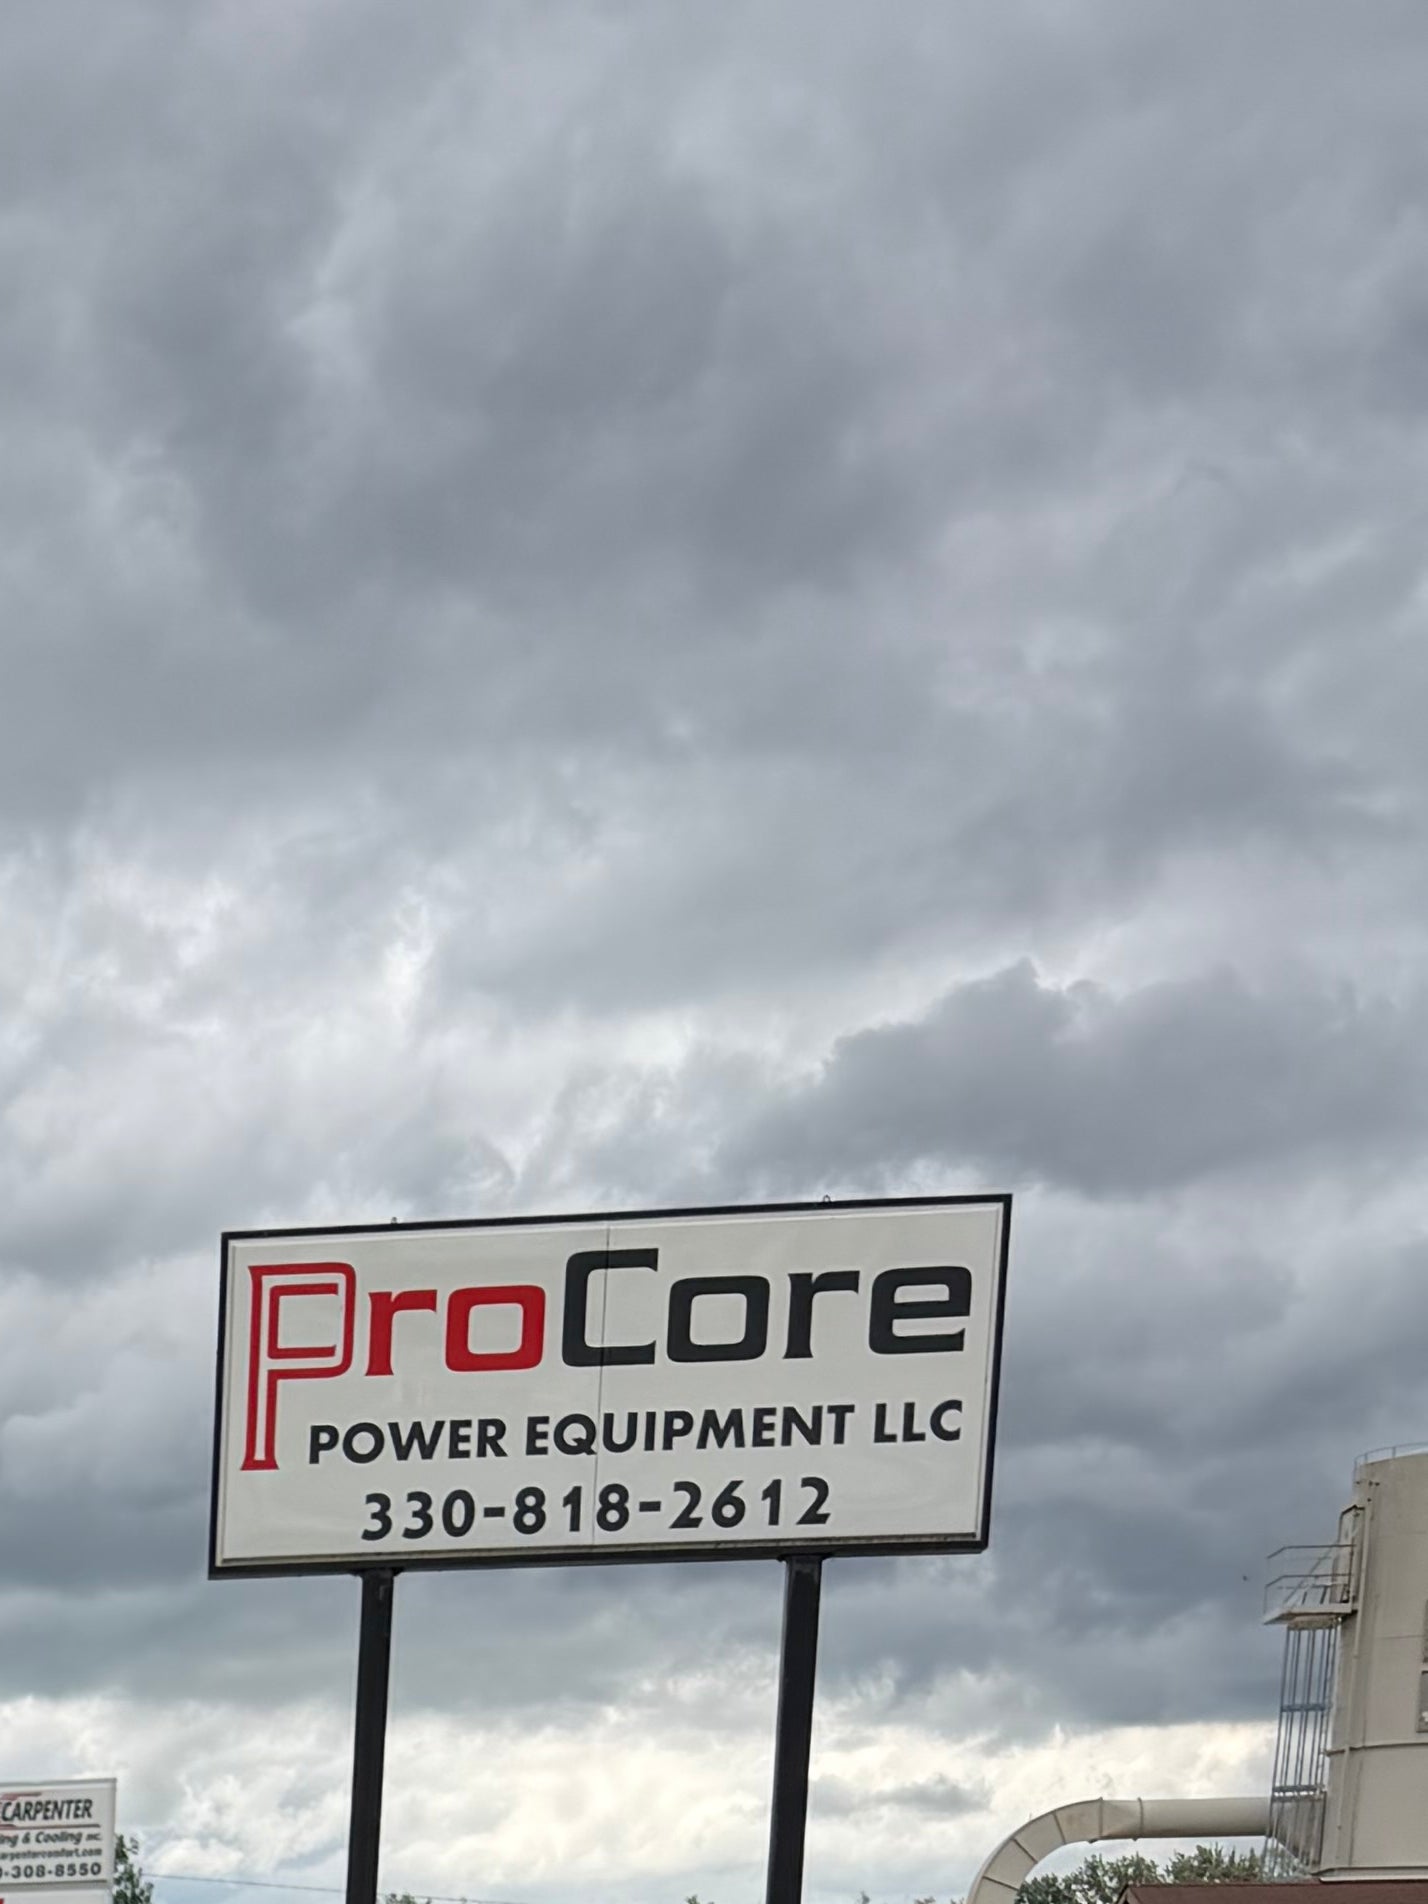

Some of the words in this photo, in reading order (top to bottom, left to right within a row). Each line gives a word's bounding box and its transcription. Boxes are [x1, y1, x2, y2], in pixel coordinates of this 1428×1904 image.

[240, 1247, 974, 1472] ProCore
[308, 1418, 508, 1466] POWER
[525, 1404, 856, 1457] EQUIPMENT
[872, 1400, 964, 1445] LLC
[360, 1476, 833, 1541] 330-818-2612
[0, 1798, 93, 1823] CARPENTER
[21, 1832, 31, 1845] &
[35, 1830, 84, 1845] Cooling
